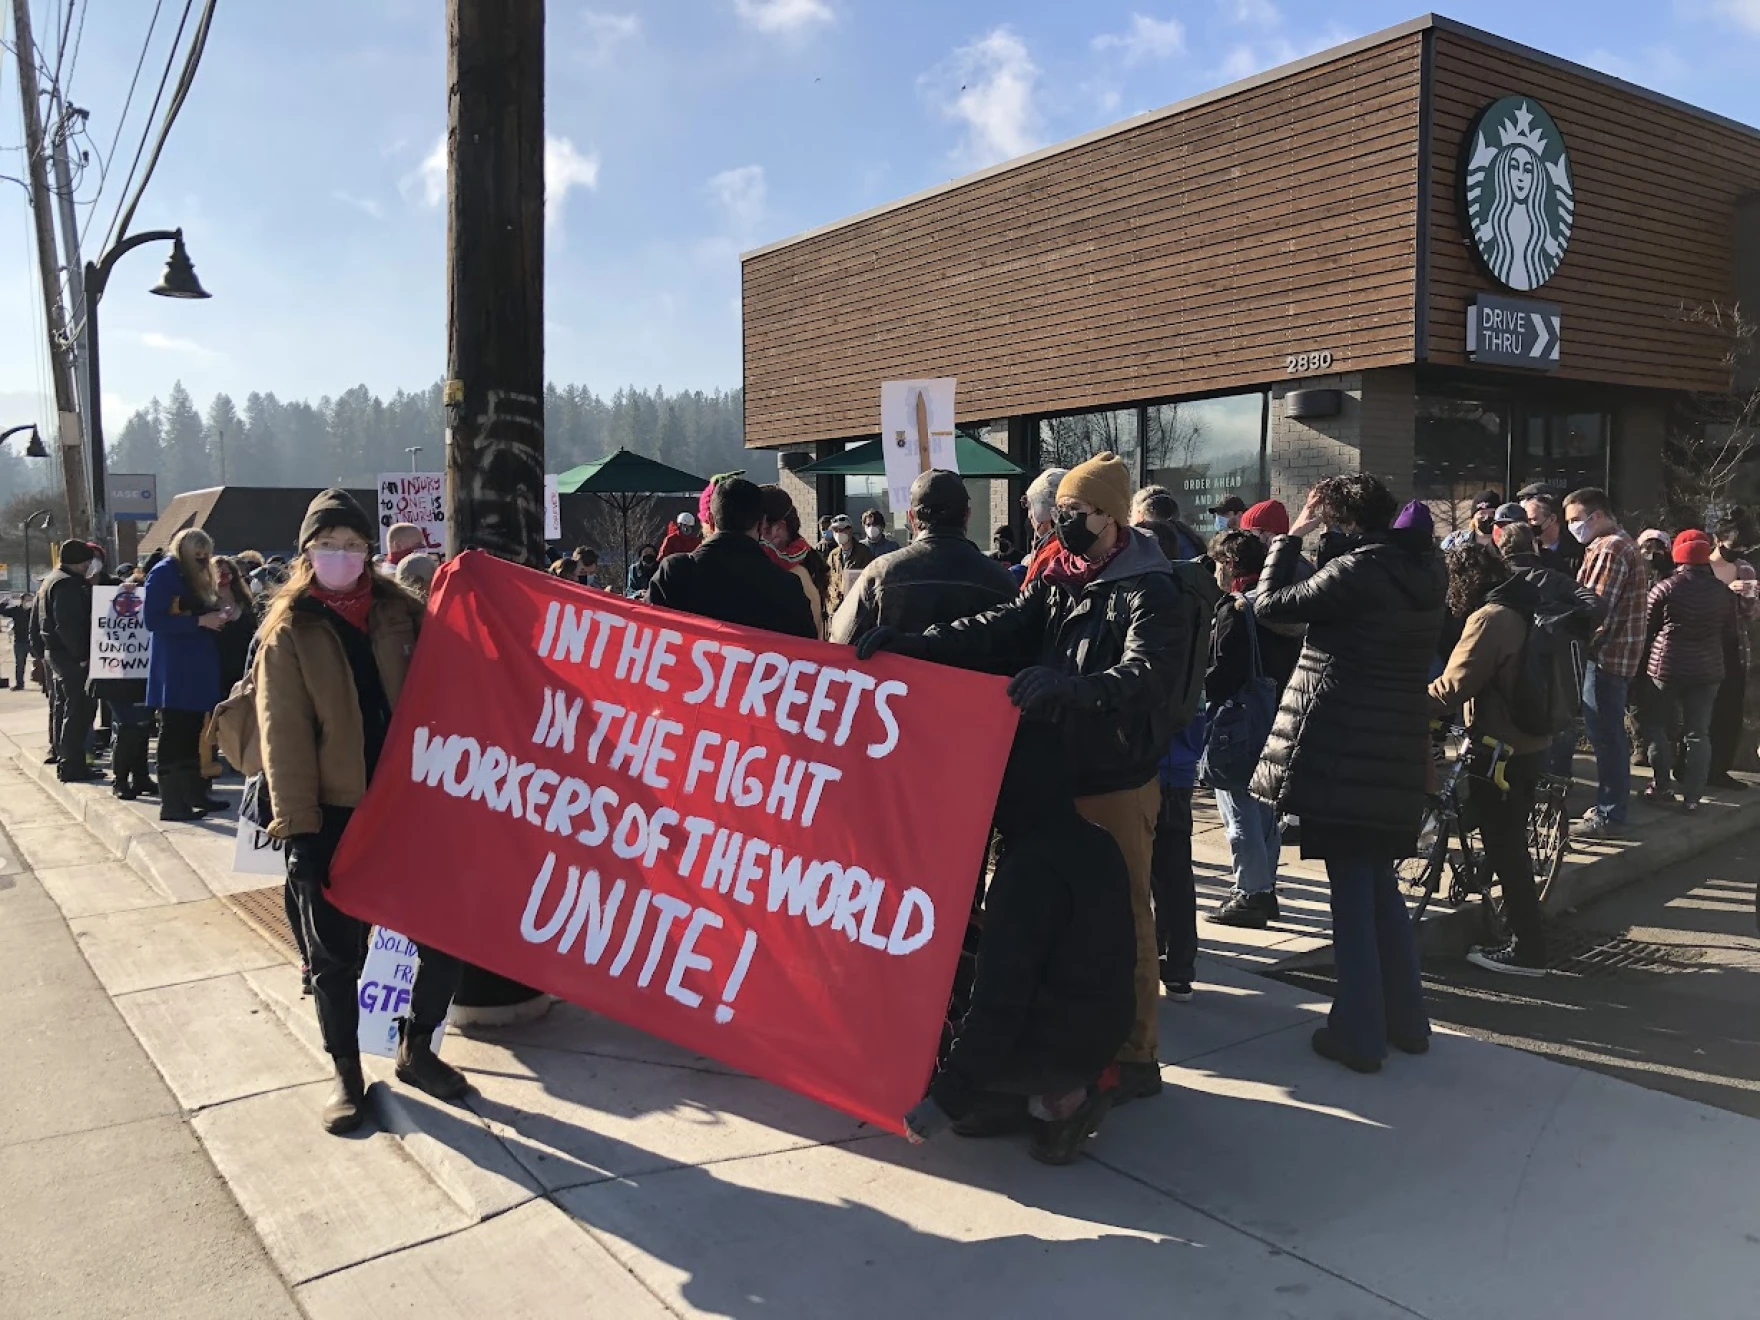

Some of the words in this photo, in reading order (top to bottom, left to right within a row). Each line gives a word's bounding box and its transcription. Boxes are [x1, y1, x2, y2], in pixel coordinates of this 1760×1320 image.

[1483, 307, 1526, 333] DRIVE
[1484, 330, 1522, 354] THRU
[1286, 351, 1332, 373] 2830
[1183, 478, 1211, 490] ORDER
[1213, 476, 1241, 488] AHEAD
[1195, 494, 1212, 505] AND
[98, 616, 144, 631] EUGEN
[107, 630, 119, 641] IS
[128, 632, 137, 640] A
[99, 642, 148, 653] UNION
[99, 656, 149, 669] TOWN
[683, 640, 908, 759] STREETS
[533, 687, 582, 753] IN
[588, 700, 684, 789] THE
[684, 730, 842, 827] FIGHT
